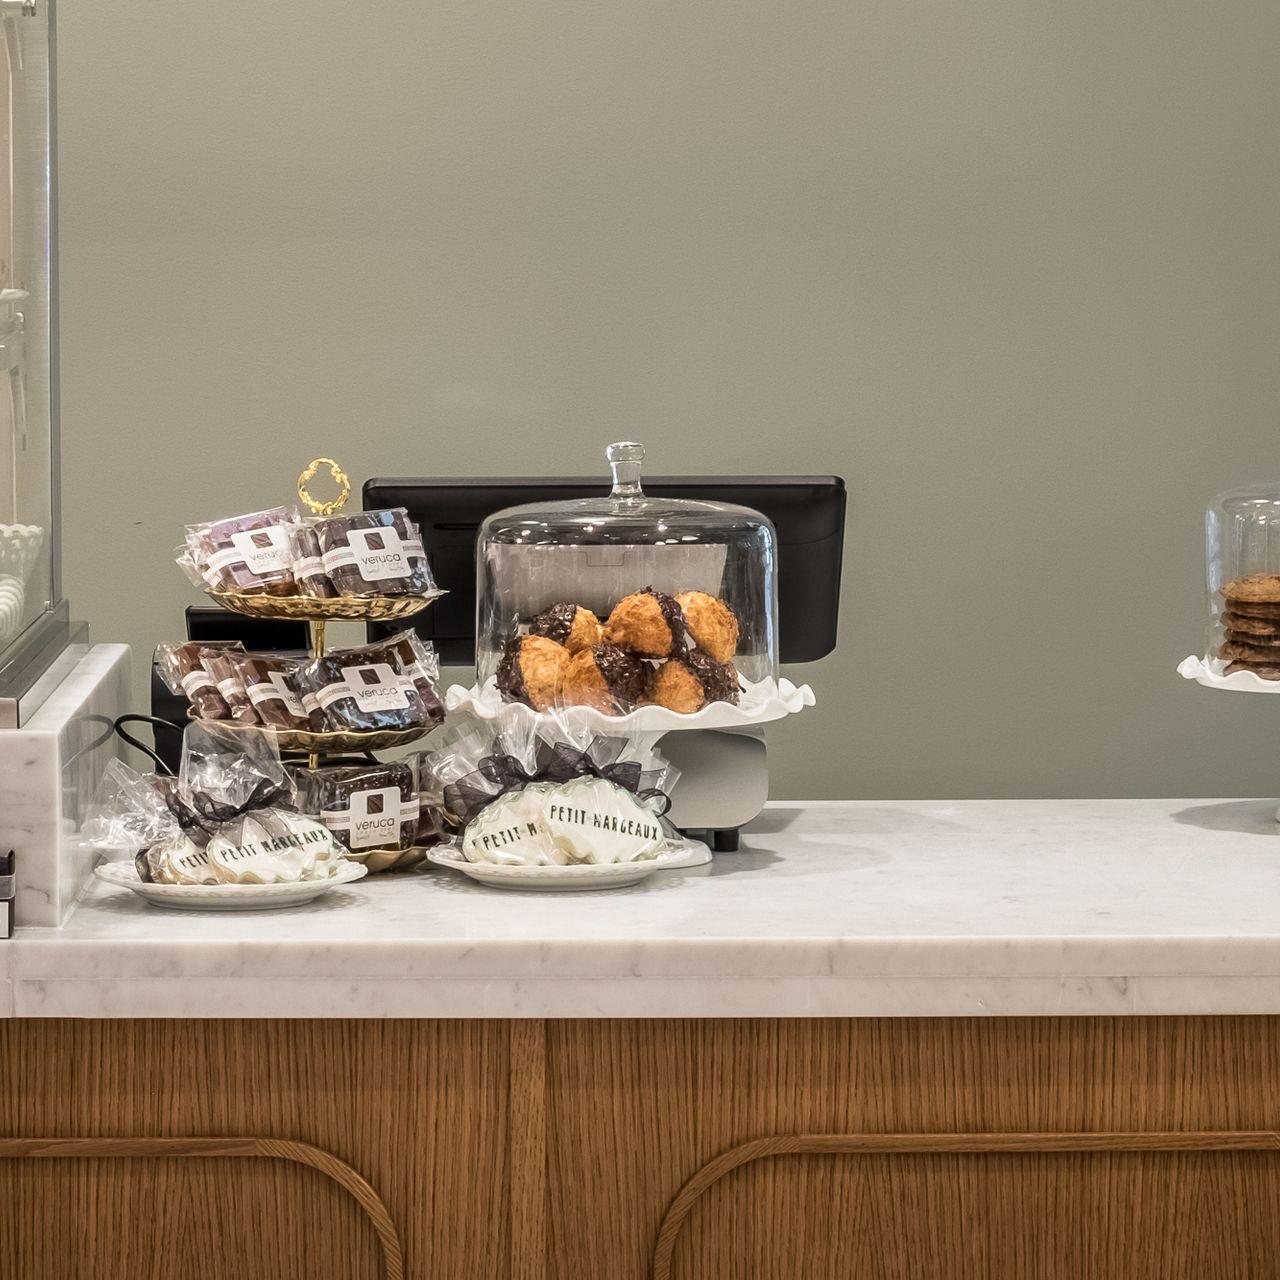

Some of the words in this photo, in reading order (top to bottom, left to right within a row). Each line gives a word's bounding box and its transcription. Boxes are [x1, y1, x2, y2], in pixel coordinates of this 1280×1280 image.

[360, 552, 402, 565] veruca
[357, 685, 399, 698] veruca
[355, 817, 395, 831] veruca
[550, 805, 586, 826] PETIT
[593, 813, 659, 841] MARGEAUX
[220, 844, 258, 863] PETIT
[260, 829, 329, 853] MARGEAUX
